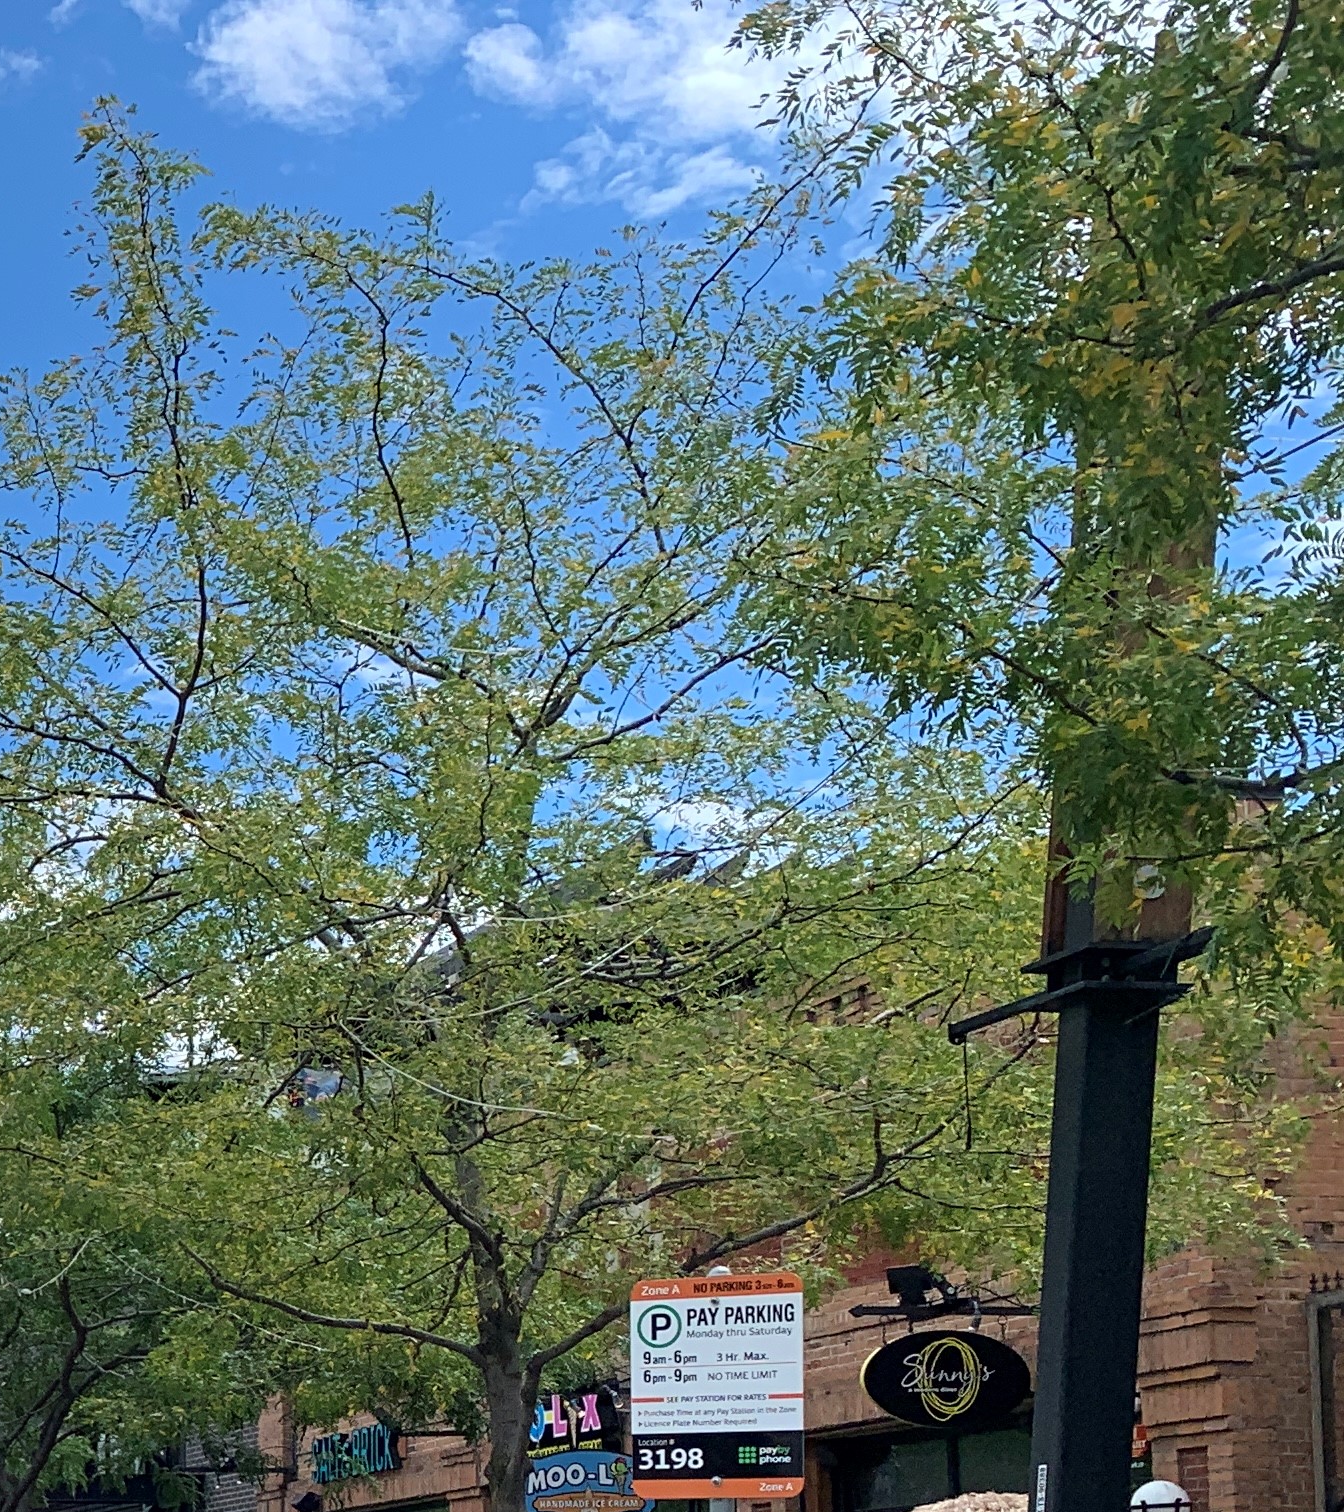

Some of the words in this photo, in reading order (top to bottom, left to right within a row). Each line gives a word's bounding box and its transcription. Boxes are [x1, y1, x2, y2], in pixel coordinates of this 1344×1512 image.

[641, 1285, 669, 1297] Zone
[672, 1284, 680, 1295] A
[693, 1282, 708, 1294] NO
[710, 1279, 753, 1294] PARKING
[651, 1313, 672, 1341] P
[687, 1307, 719, 1327] PAY
[725, 1303, 795, 1325] PARKING
[687, 1329, 724, 1340] Monday
[726, 1327, 747, 1338] thru
[749, 1326, 793, 1338] Saturday
[716, 1352, 723, 1362] 3
[743, 1351, 770, 1361] Max.
[707, 1372, 723, 1381] NO
[725, 1371, 749, 1381] TIME
[751, 1370, 778, 1380] LIMIT
[743, 1393, 767, 1401] RATES
[352, 1422, 394, 1476] BRICK
[638, 1448, 704, 1470] 3198
[759, 1454, 792, 1466] phone
[759, 1482, 784, 1492] Zone
[785, 1482, 794, 1491] A
[539, 1500, 590, 1509] HANDMADE
[592, 1500, 605, 1508] ICE
[608, 1499, 639, 1508] CREAM
